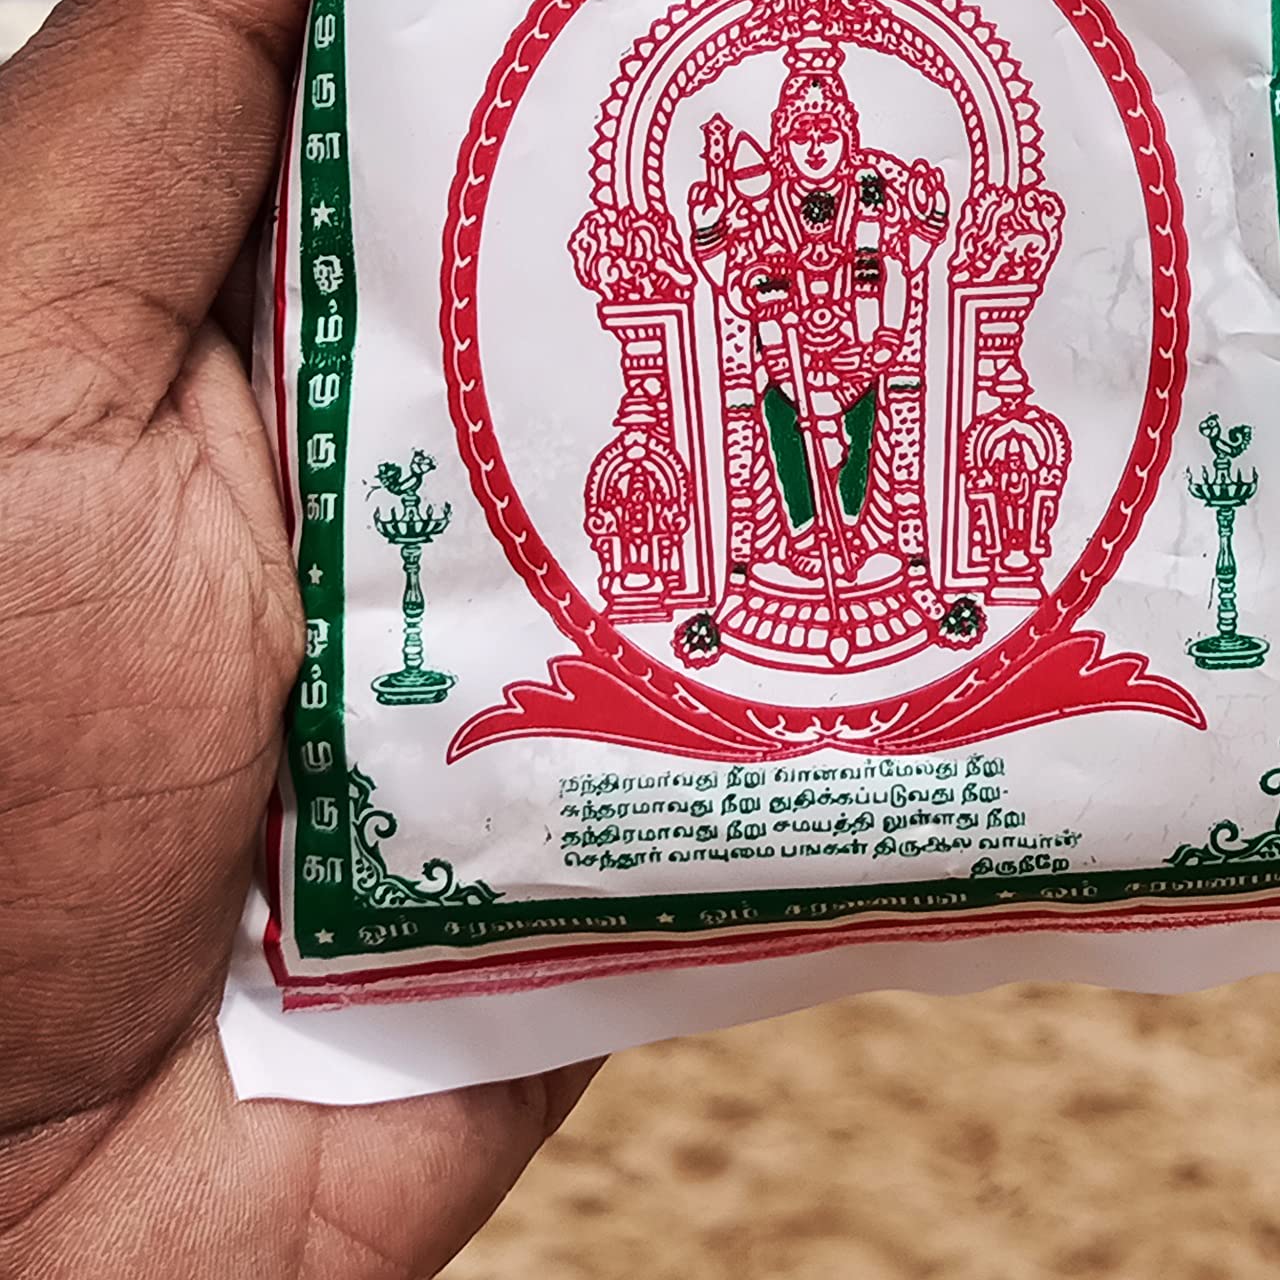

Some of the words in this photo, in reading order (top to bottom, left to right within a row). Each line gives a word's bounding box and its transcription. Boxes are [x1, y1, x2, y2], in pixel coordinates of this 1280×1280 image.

[720, 792, 762, 816] நீறு
[768, 783, 955, 814] துதிக்கப்படுவது
[560, 822, 719, 849] தந்திரமாவது
[726, 818, 767, 842] நீறு
[986, 807, 1027, 831] நீறு
[563, 846, 664, 872] செந்தூர்
